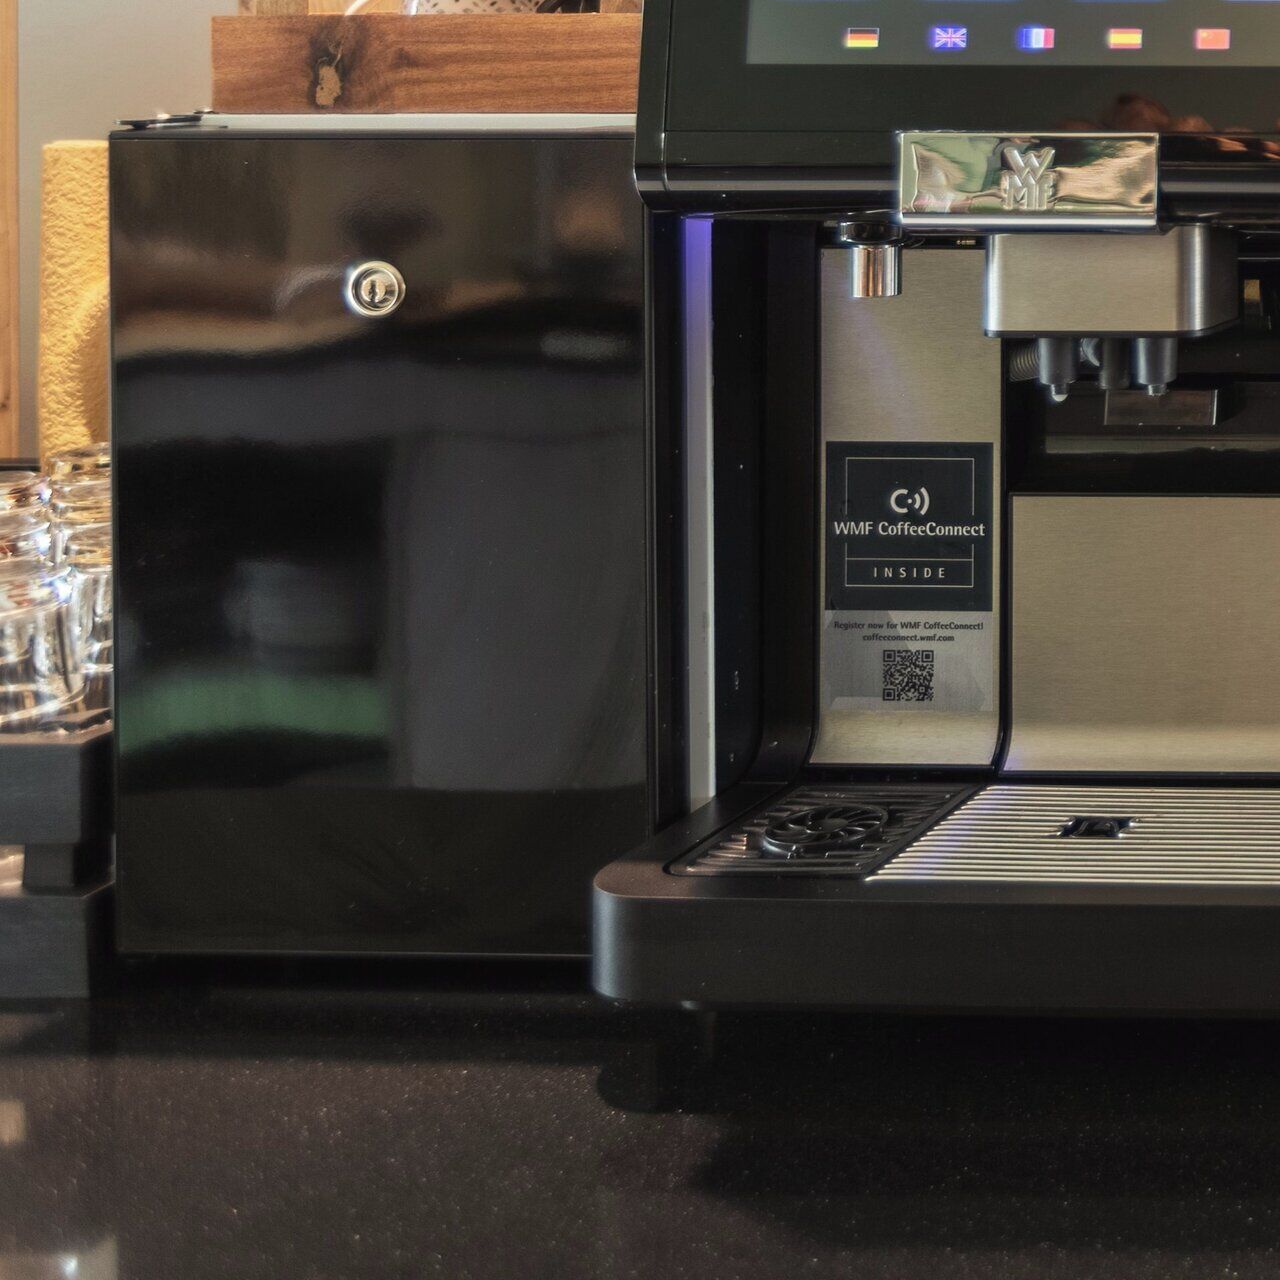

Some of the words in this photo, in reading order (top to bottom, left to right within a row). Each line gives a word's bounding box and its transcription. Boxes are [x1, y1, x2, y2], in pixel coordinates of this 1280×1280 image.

[1002, 146, 1056, 211] WMF
[834, 521, 874, 535] WMF
[878, 521, 986, 536] CoffeeConnect
[873, 567, 946, 578] INSIDE
[834, 620, 865, 631] Register
[886, 620, 898, 629] for
[900, 621, 921, 630] WMF
[862, 632, 955, 642] coffeeconnect.wmf.com
